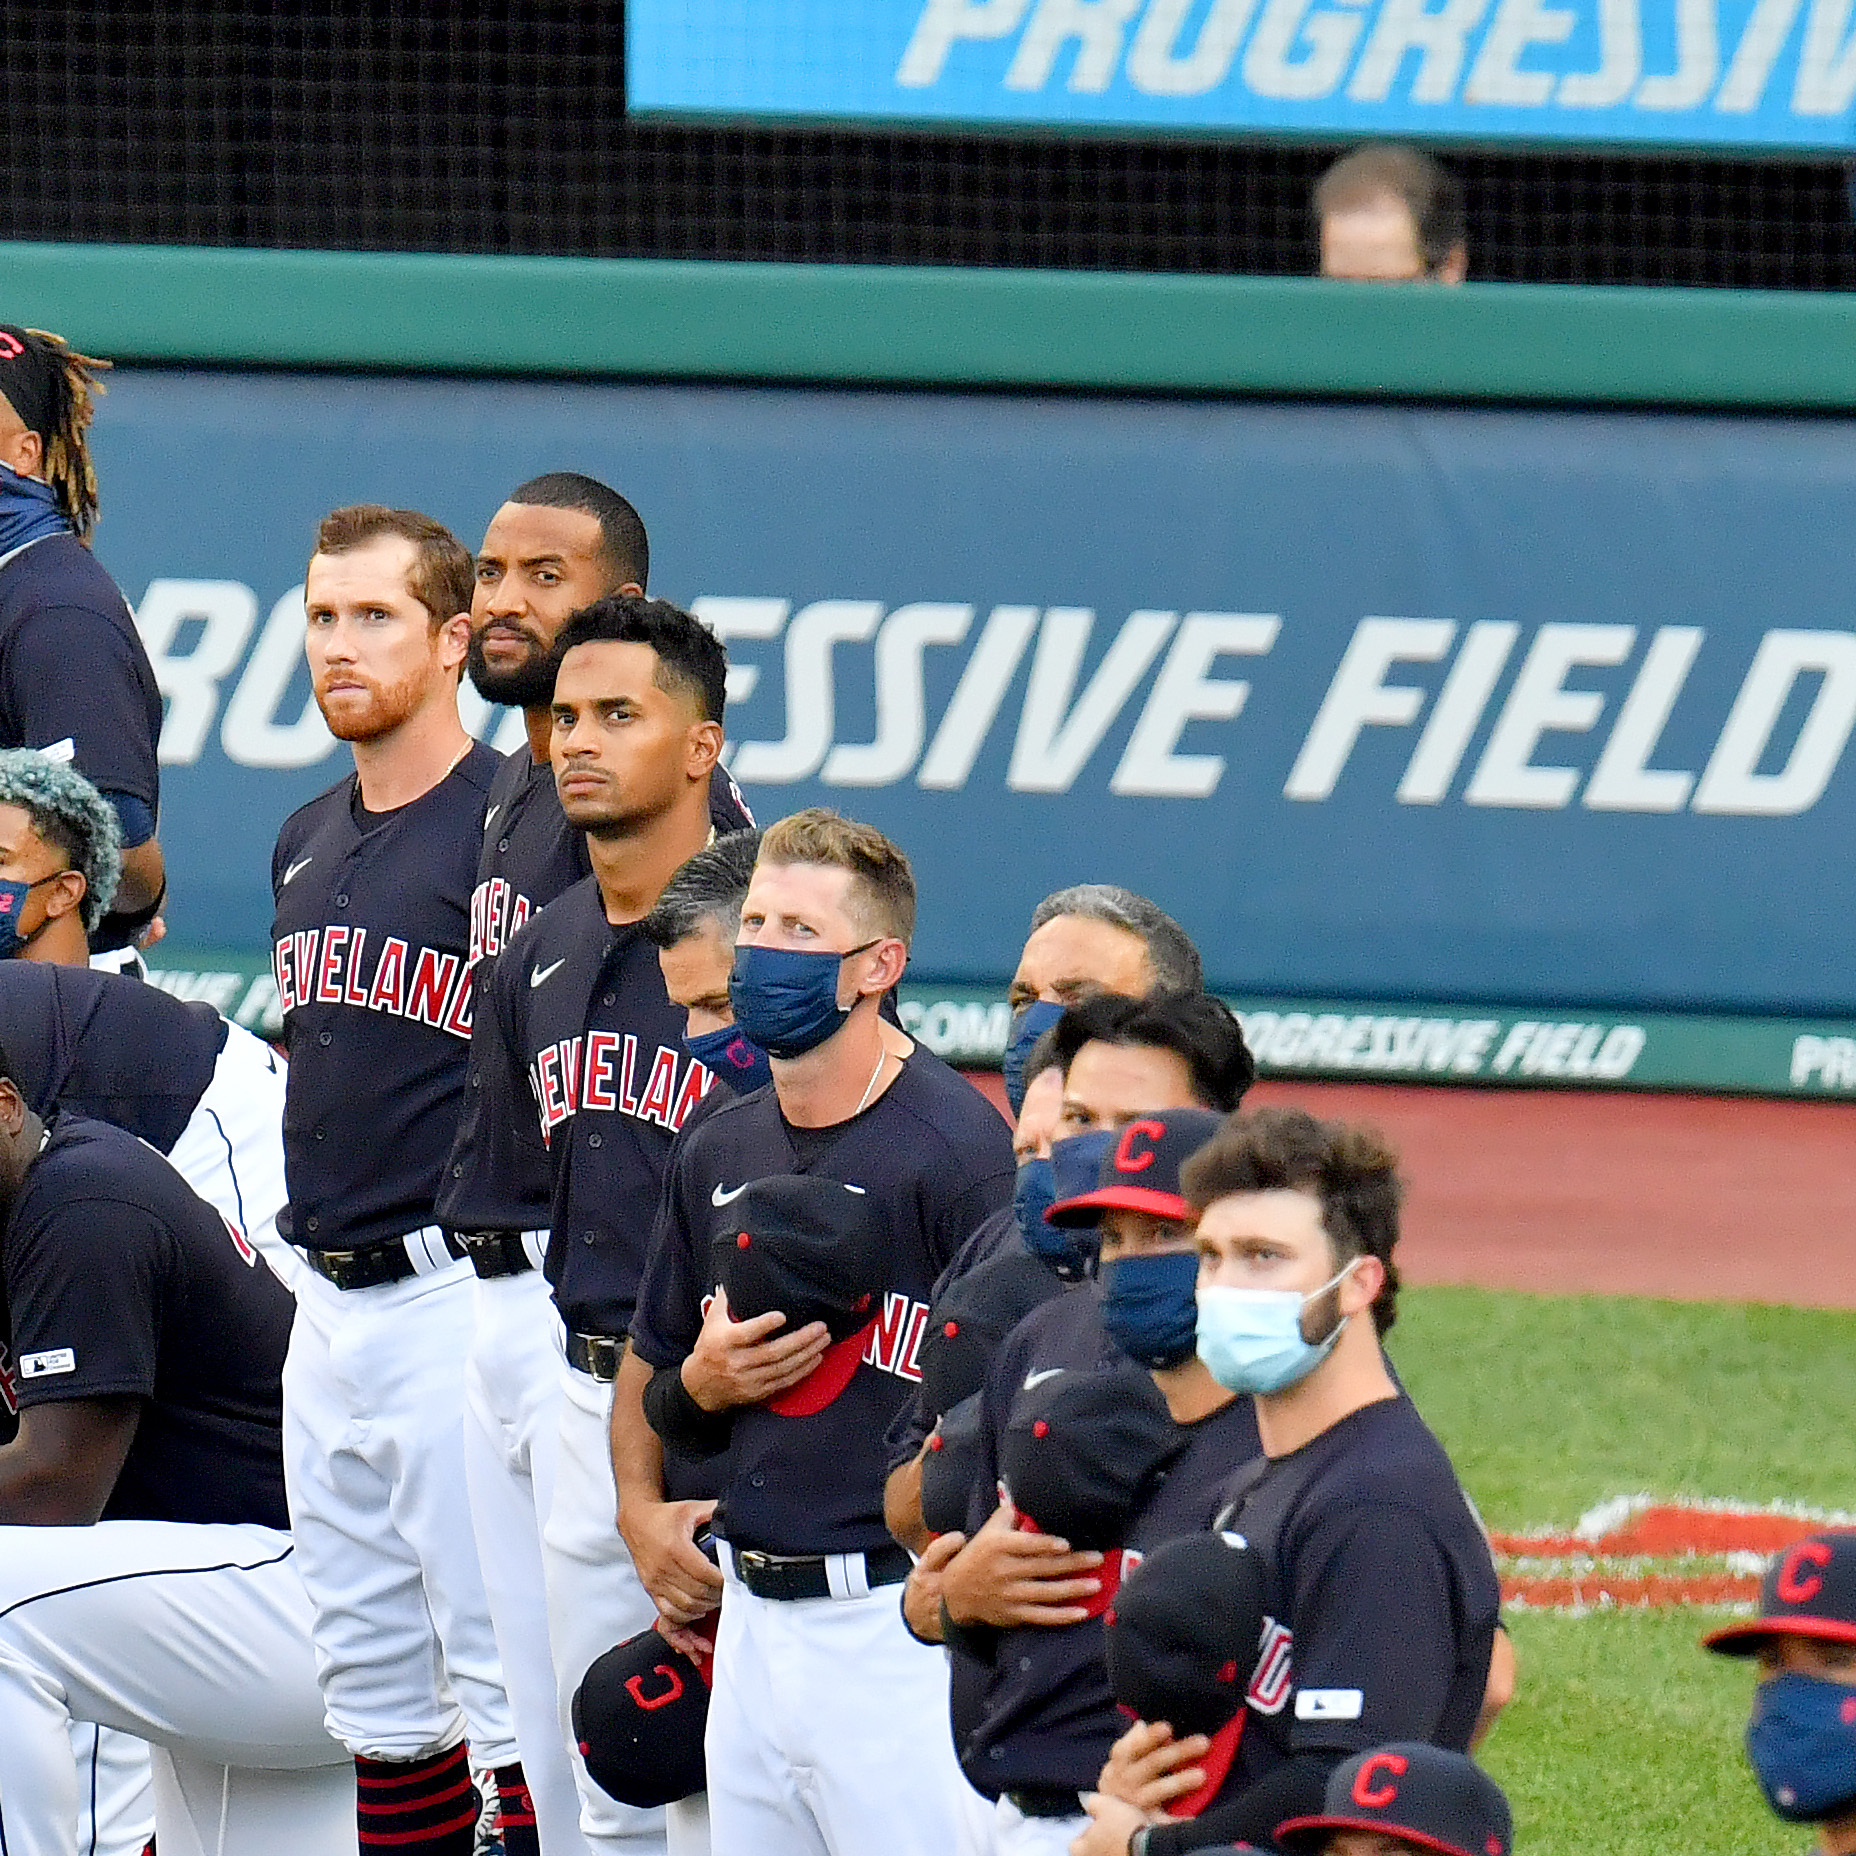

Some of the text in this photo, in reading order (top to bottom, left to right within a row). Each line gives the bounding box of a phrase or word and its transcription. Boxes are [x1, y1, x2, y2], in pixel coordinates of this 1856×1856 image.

[1490, 1020, 1645, 1079] FIELD
[1114, 1119, 1167, 1173] C
[1776, 1542, 1833, 1604] C
[624, 1664, 684, 1711] C
[1351, 1753, 1408, 1808] C
